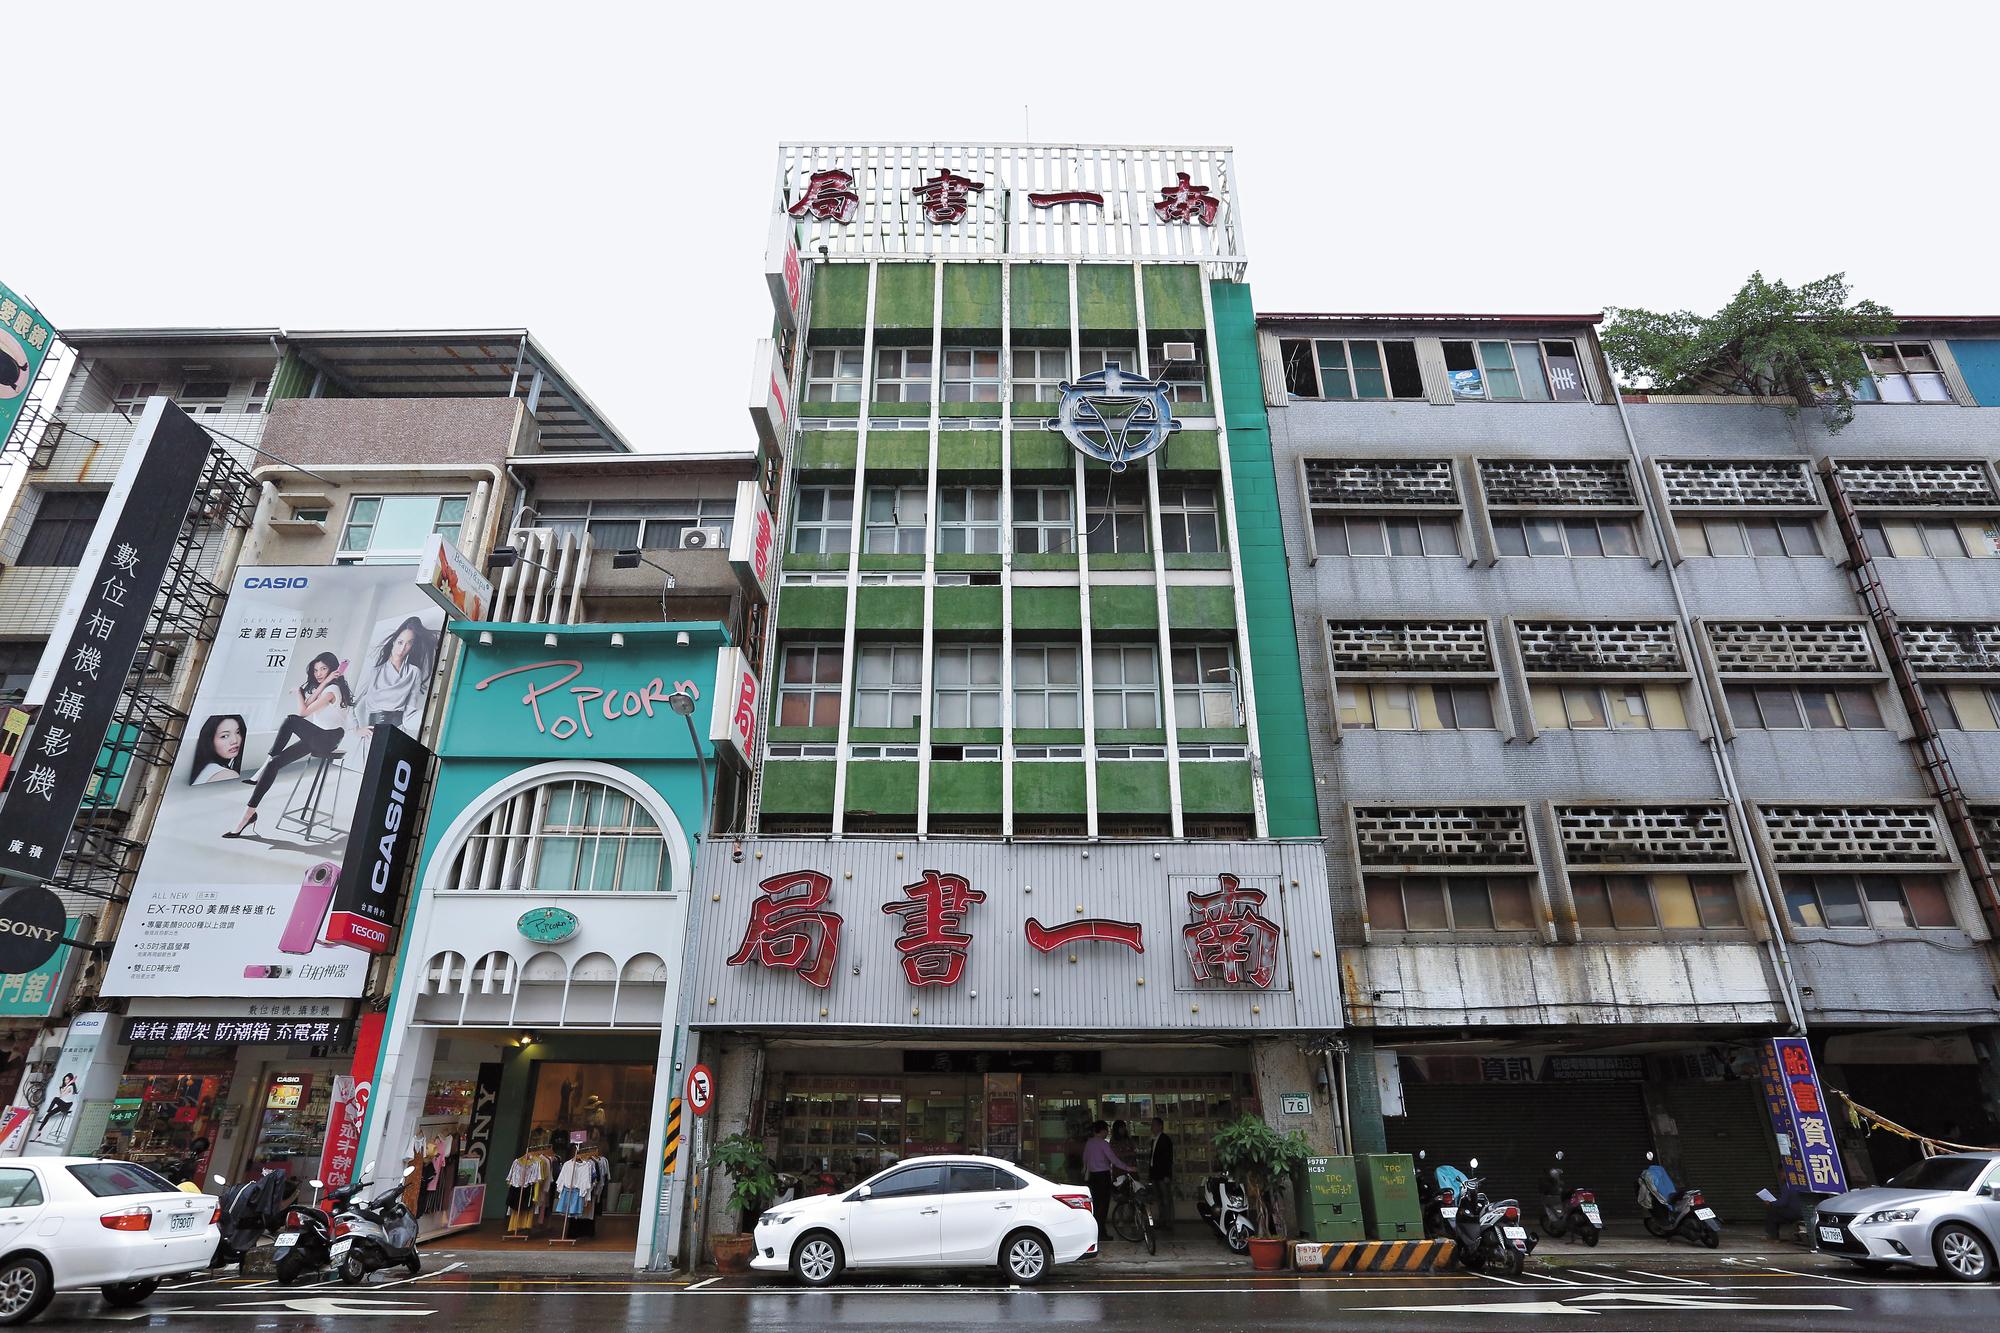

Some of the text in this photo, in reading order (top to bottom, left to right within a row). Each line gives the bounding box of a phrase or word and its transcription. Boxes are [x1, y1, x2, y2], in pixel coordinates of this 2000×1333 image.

[244, 577, 309, 588] CASIO
[238, 628, 329, 639] 定義自己的美
[371, 759, 412, 894] CASIO
[152, 892, 189, 900] ALL NEW
[147, 904, 204, 915] EX-TR80
[0, 918, 59, 943] SONY
[351, 923, 385, 943] TESCOM
[1288, 1101, 1304, 1112] 76
